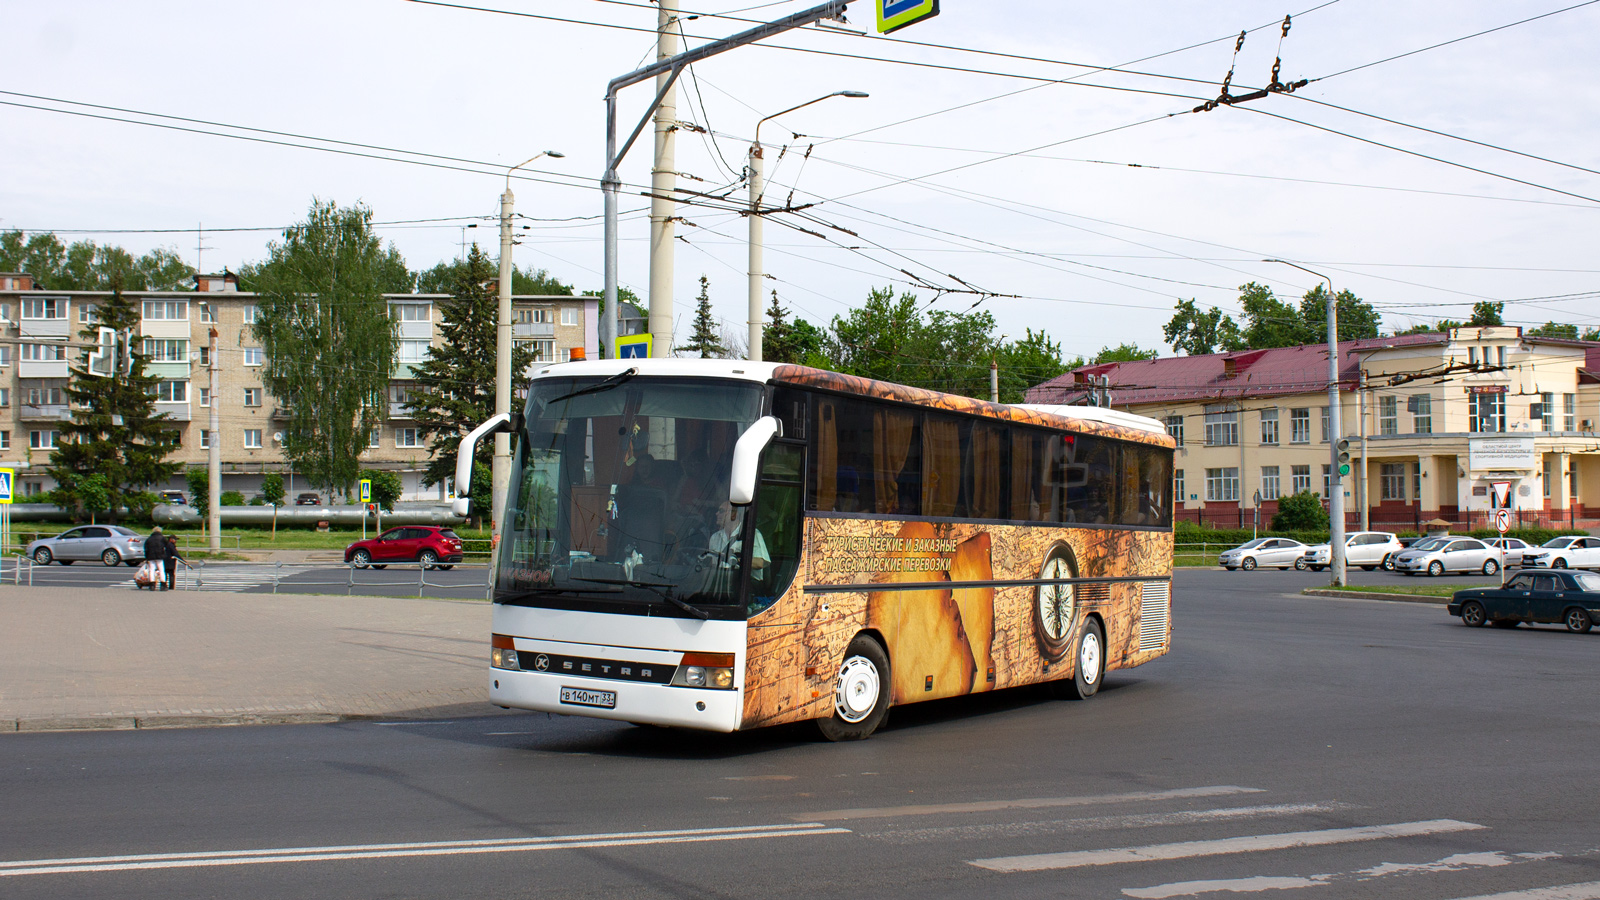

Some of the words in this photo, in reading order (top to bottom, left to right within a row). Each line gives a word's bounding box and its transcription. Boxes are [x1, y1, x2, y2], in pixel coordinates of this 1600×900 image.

[826, 536, 904, 552] ТУРИСТИЧЕСКИЕ
[905, 538, 912, 552] И
[914, 538, 957, 552] ЗАКАЗНЫЕ
[825, 557, 902, 573] ПАССАЖИРСКИЕ
[903, 558, 952, 571] ПЕРЕВОЗКИ
[562, 660, 653, 678] SETRA
